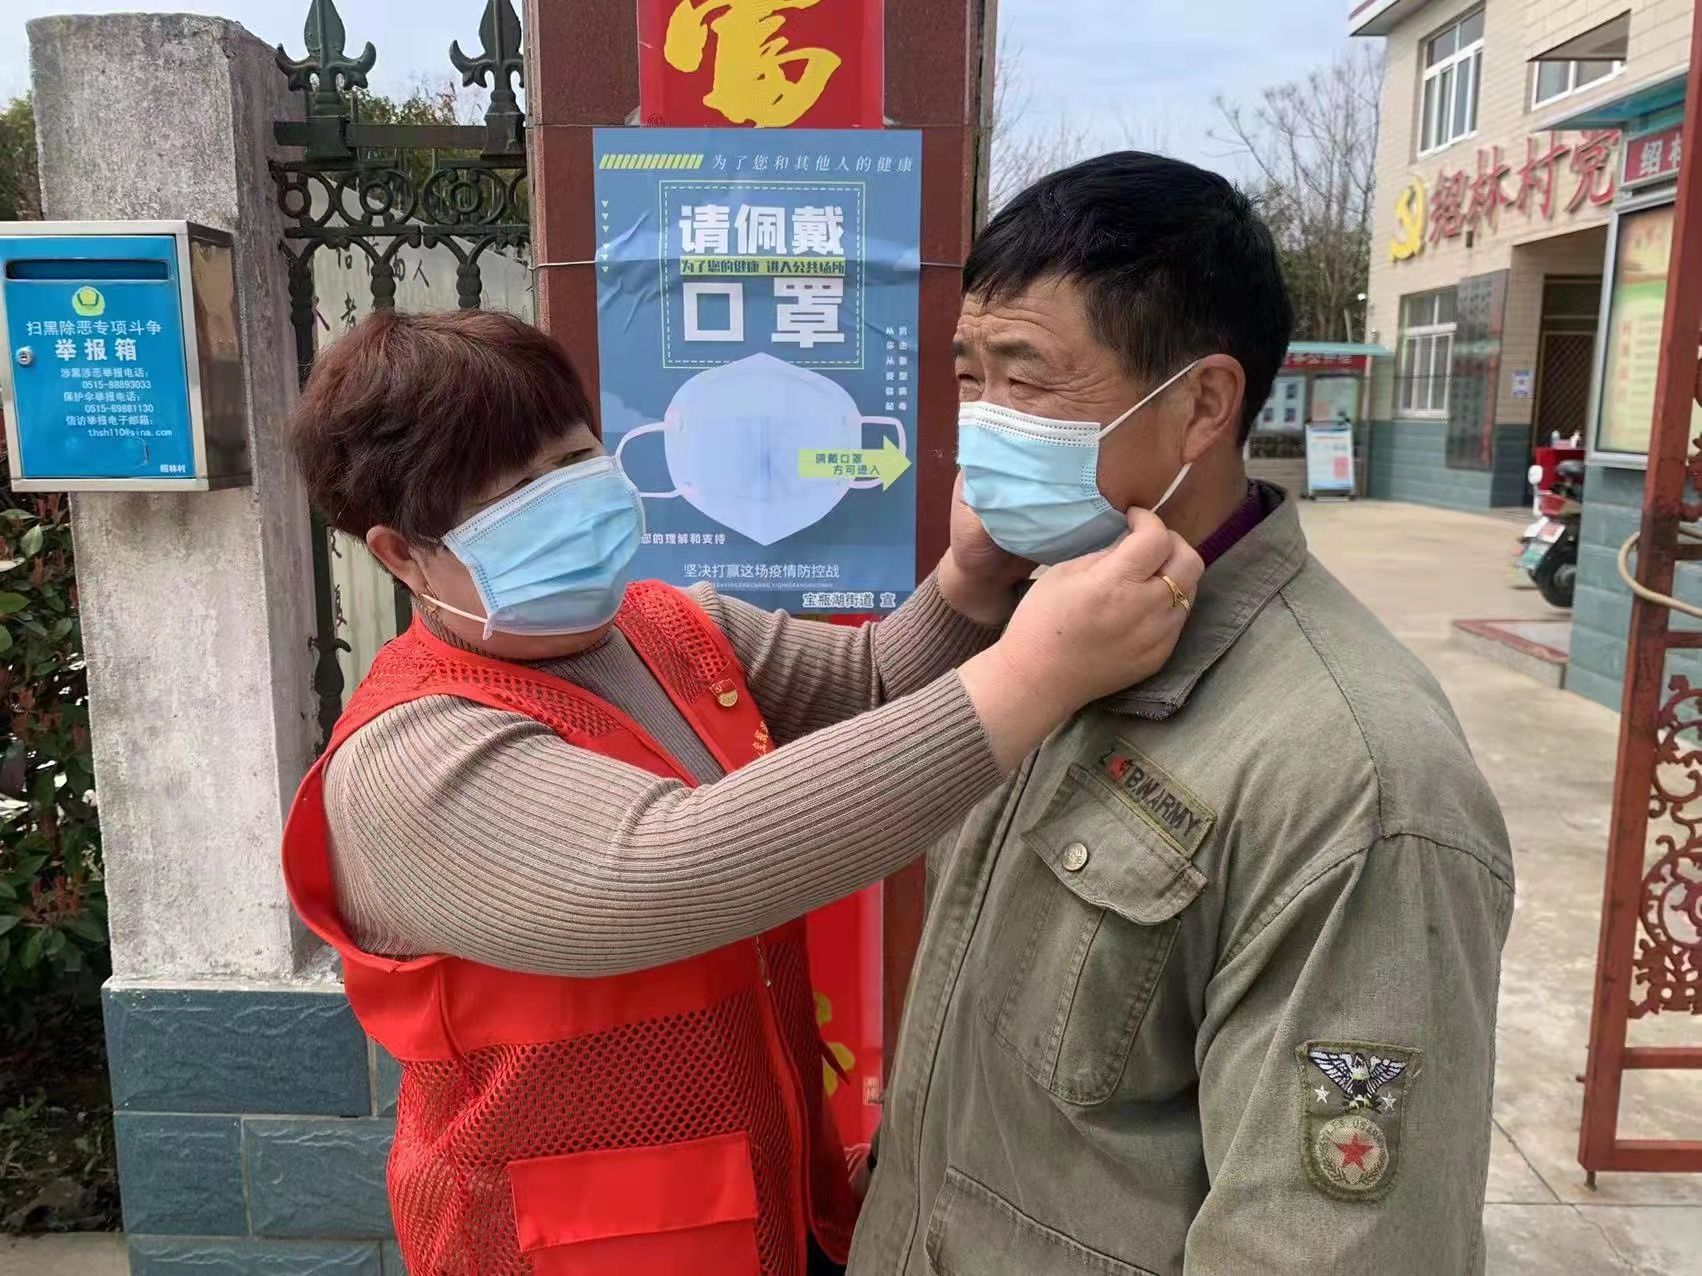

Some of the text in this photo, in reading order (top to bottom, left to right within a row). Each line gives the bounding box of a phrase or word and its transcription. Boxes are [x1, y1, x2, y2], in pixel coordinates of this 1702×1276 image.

[711, 153, 915, 173] 为了您和其他人的健康
[678, 203, 845, 255] 请佩戴
[681, 259, 845, 275] 为了您的健康 进入公共场所
[682, 277, 846, 349] 口罩
[26, 319, 162, 336] 扫黑除恶专项斗争
[55, 338, 138, 362] 举报箱
[833, 464, 881, 476] 方可进入
[683, 563, 840, 579] 坚决打赢这场疫情防控战
[802, 592, 896, 608] 宝瓶湖街道 宣
